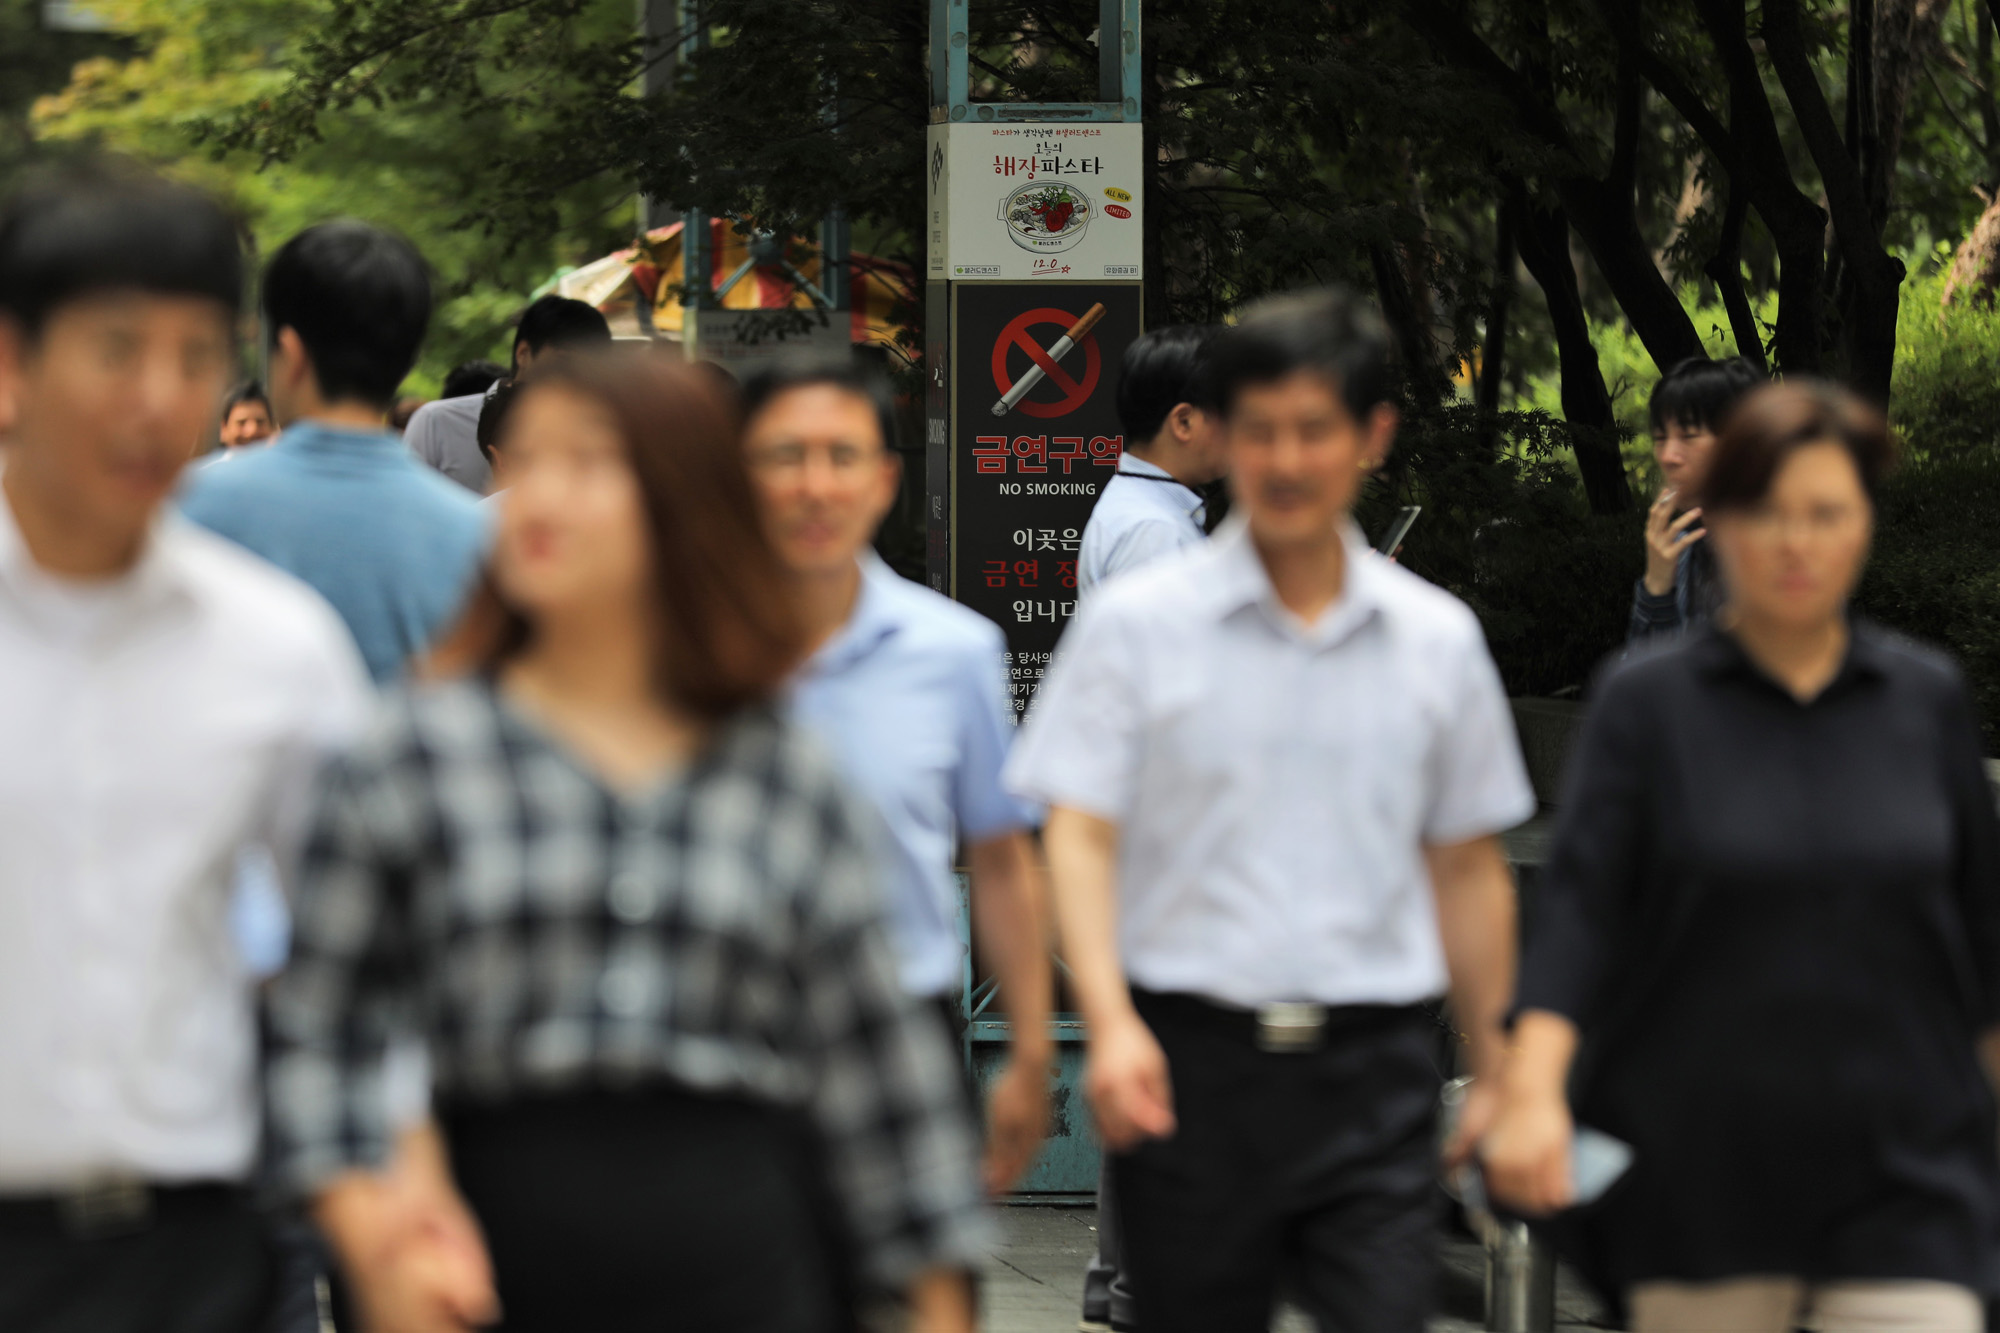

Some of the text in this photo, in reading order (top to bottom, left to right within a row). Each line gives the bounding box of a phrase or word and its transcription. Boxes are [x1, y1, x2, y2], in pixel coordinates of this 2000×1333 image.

[992, 129, 1020, 137] 파스타가
[1034, 141, 1062, 156] 오늘의
[992, 155, 1104, 179] 해장파스타
[1105, 189, 1130, 201] ALL NEW
[1105, 206, 1130, 218] LIMITED
[972, 435, 1124, 474] 금연구역
[1000, 483, 1096, 495] NO SMOKING
[1013, 528, 1082, 551] 이곳은
[982, 559, 1039, 588] 금연
[1013, 600, 1080, 622] 입니다
[1018, 652, 1053, 664] 당사의
